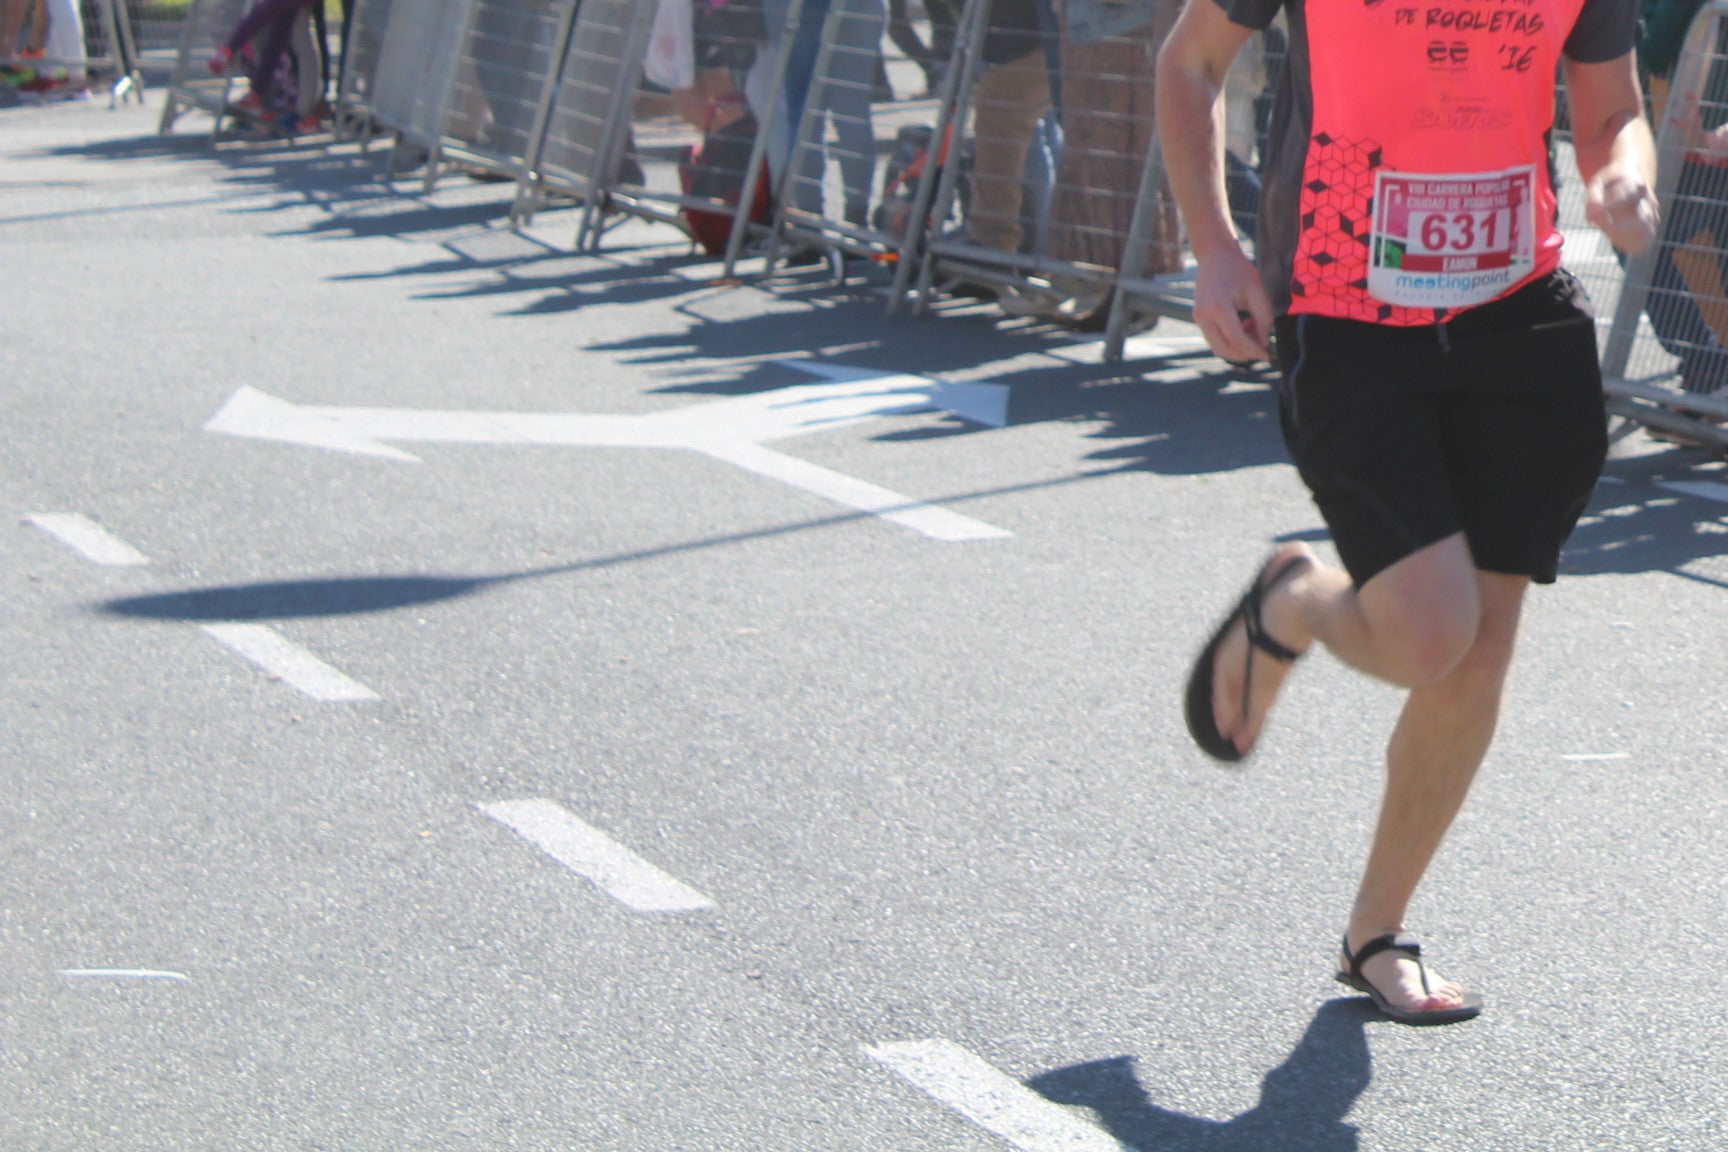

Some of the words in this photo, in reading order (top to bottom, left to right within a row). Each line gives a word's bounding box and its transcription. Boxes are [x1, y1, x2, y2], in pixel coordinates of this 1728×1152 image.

[1395, 8, 1417, 24] DE
[1421, 210, 1498, 252] 631
[1395, 270, 1511, 291] meetingpoint
